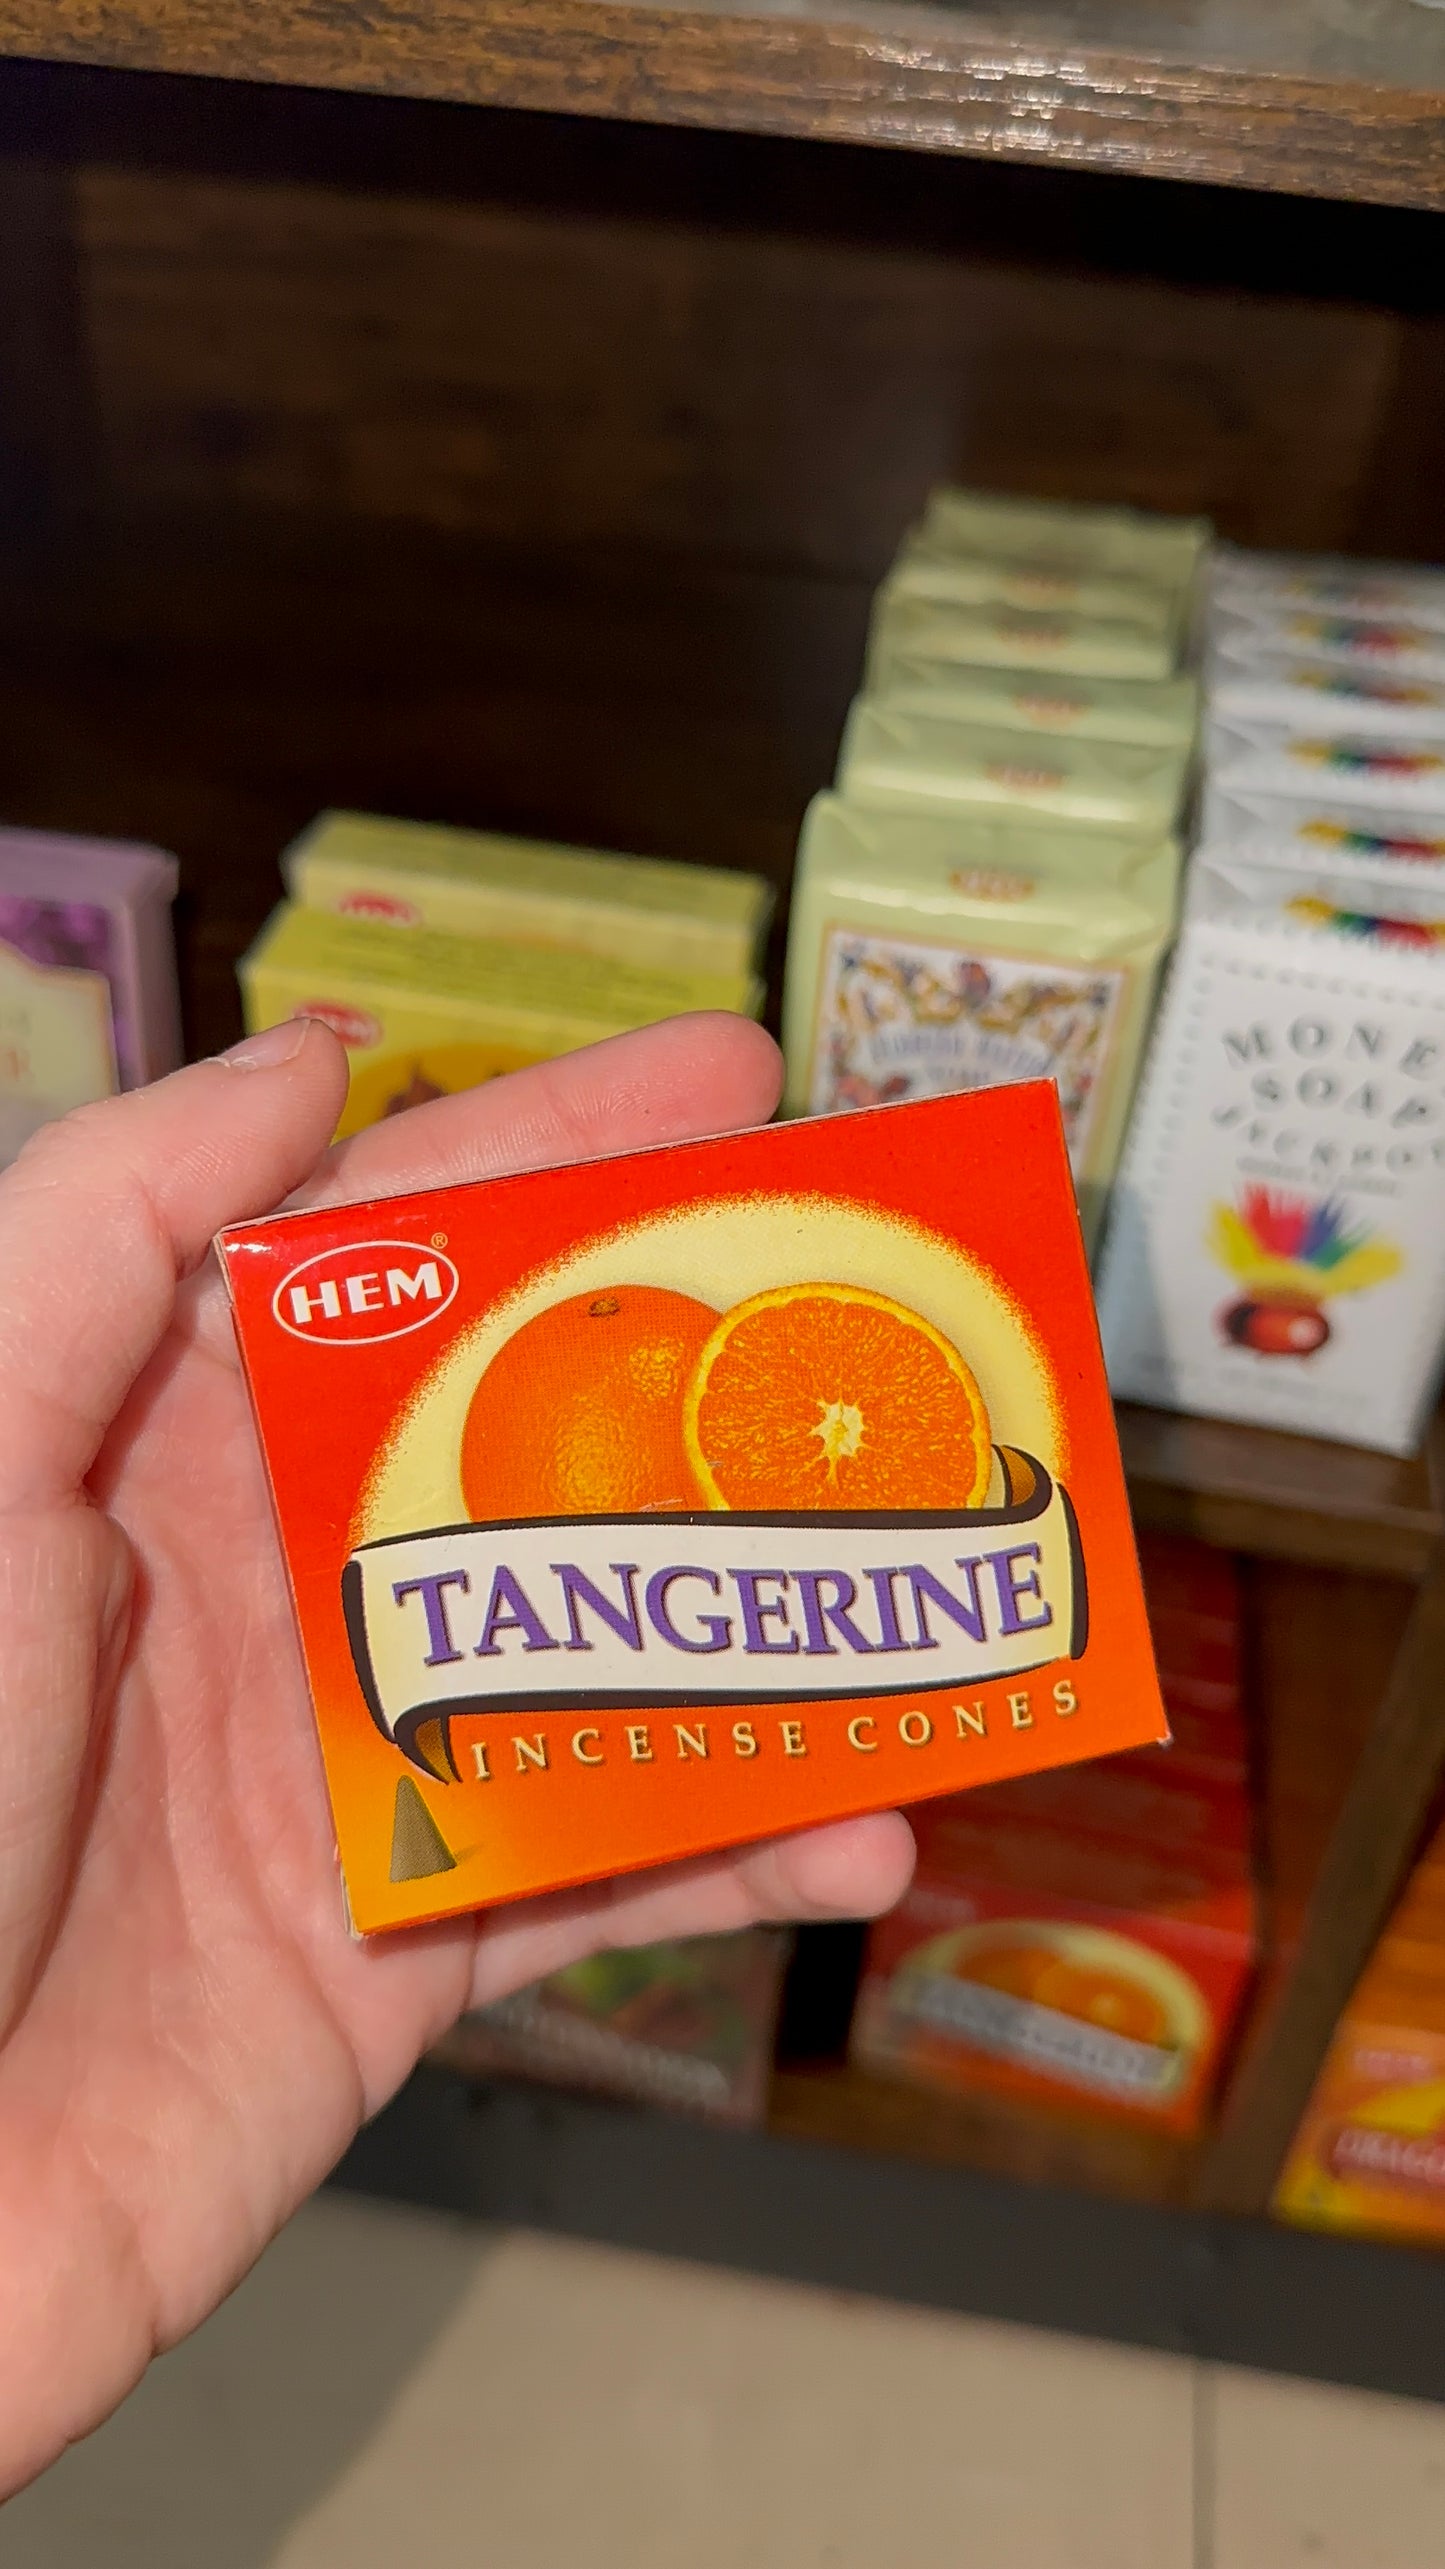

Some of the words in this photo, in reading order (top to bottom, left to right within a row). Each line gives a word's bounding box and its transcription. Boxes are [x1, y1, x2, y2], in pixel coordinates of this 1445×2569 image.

[1221, 1016, 1445, 1080] MONE
[1250, 1066, 1434, 1129] SOAP
[290, 1262, 442, 1323] HEM
[392, 1542, 1053, 1667] TANGERINE
[471, 1720, 807, 1780] INCENSE
[847, 1679, 1077, 1751] CONES
